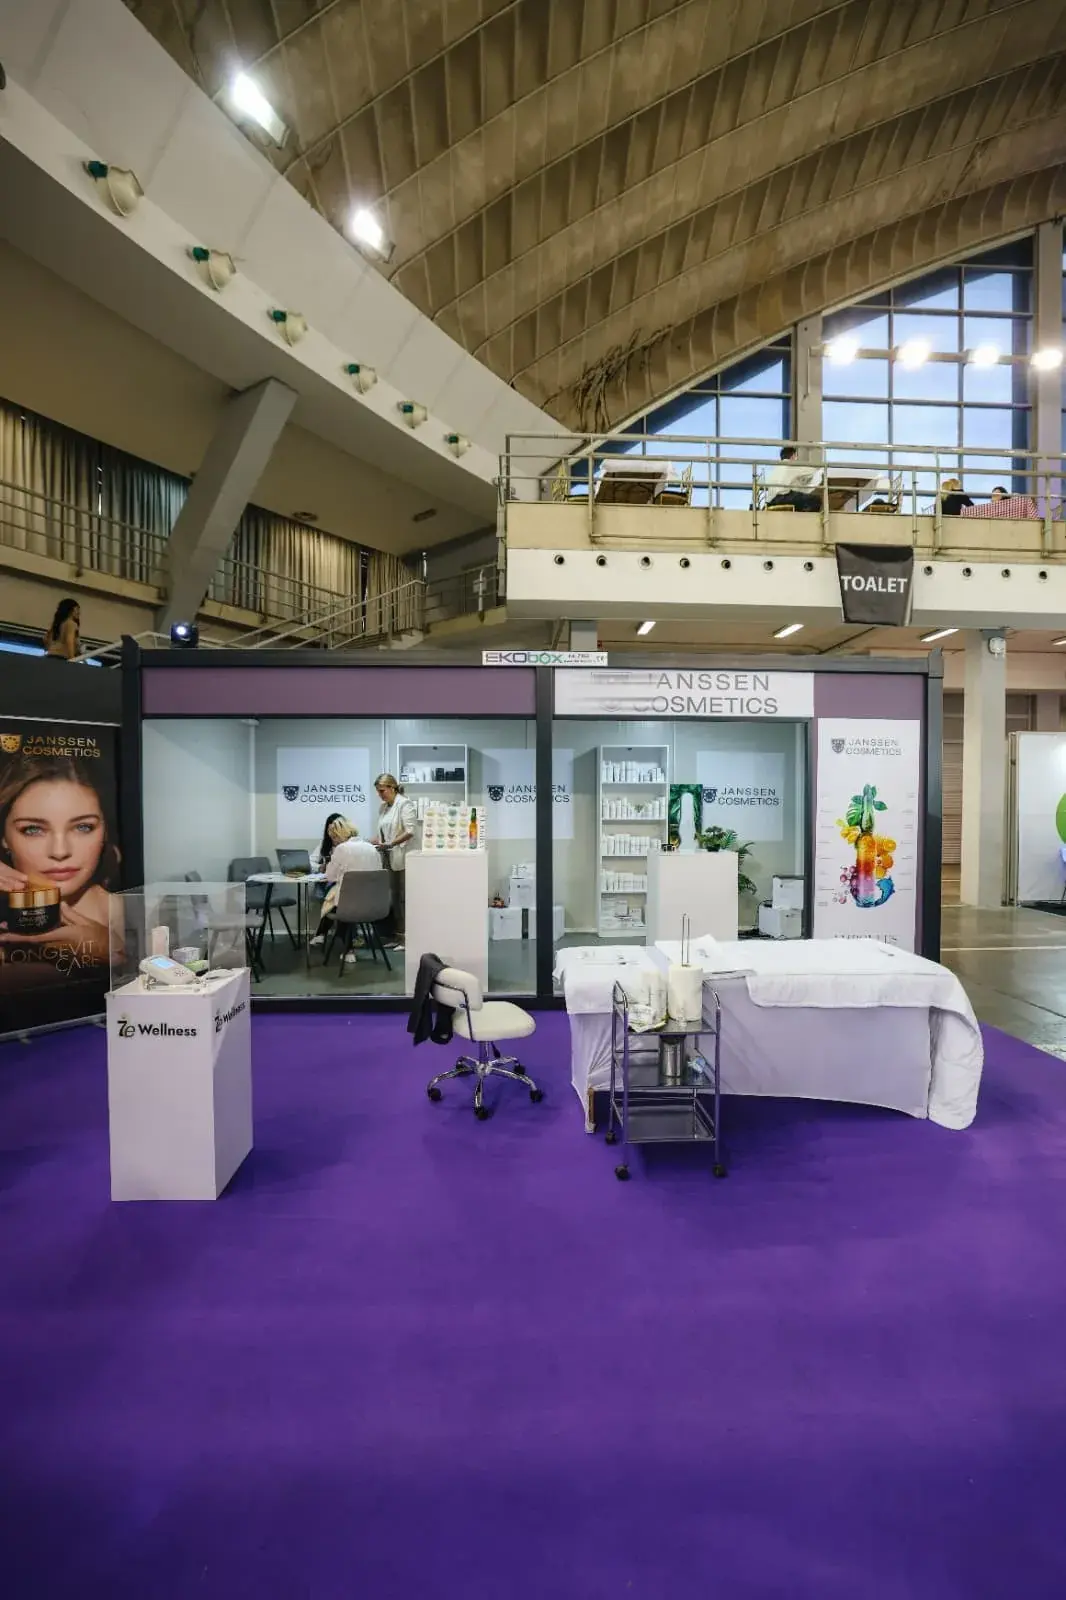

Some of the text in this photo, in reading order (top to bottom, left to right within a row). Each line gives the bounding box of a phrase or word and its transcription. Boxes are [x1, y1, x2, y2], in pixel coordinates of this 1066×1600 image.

[840, 575, 908, 593] TOALET
[27, 735, 97, 747] JANSSEN
[847, 738, 898, 747] JANSSEN
[22, 745, 101, 758] COSMETICS
[845, 746, 902, 756] COSMETICS
[303, 784, 361, 793] JANSSEN
[508, 784, 566, 793] JANEN
[721, 787, 776, 796] JANSSEN
[300, 794, 366, 803] COSMETICS
[718, 797, 780, 806] COSMETICS
[138, 1023, 197, 1037] Wellness
